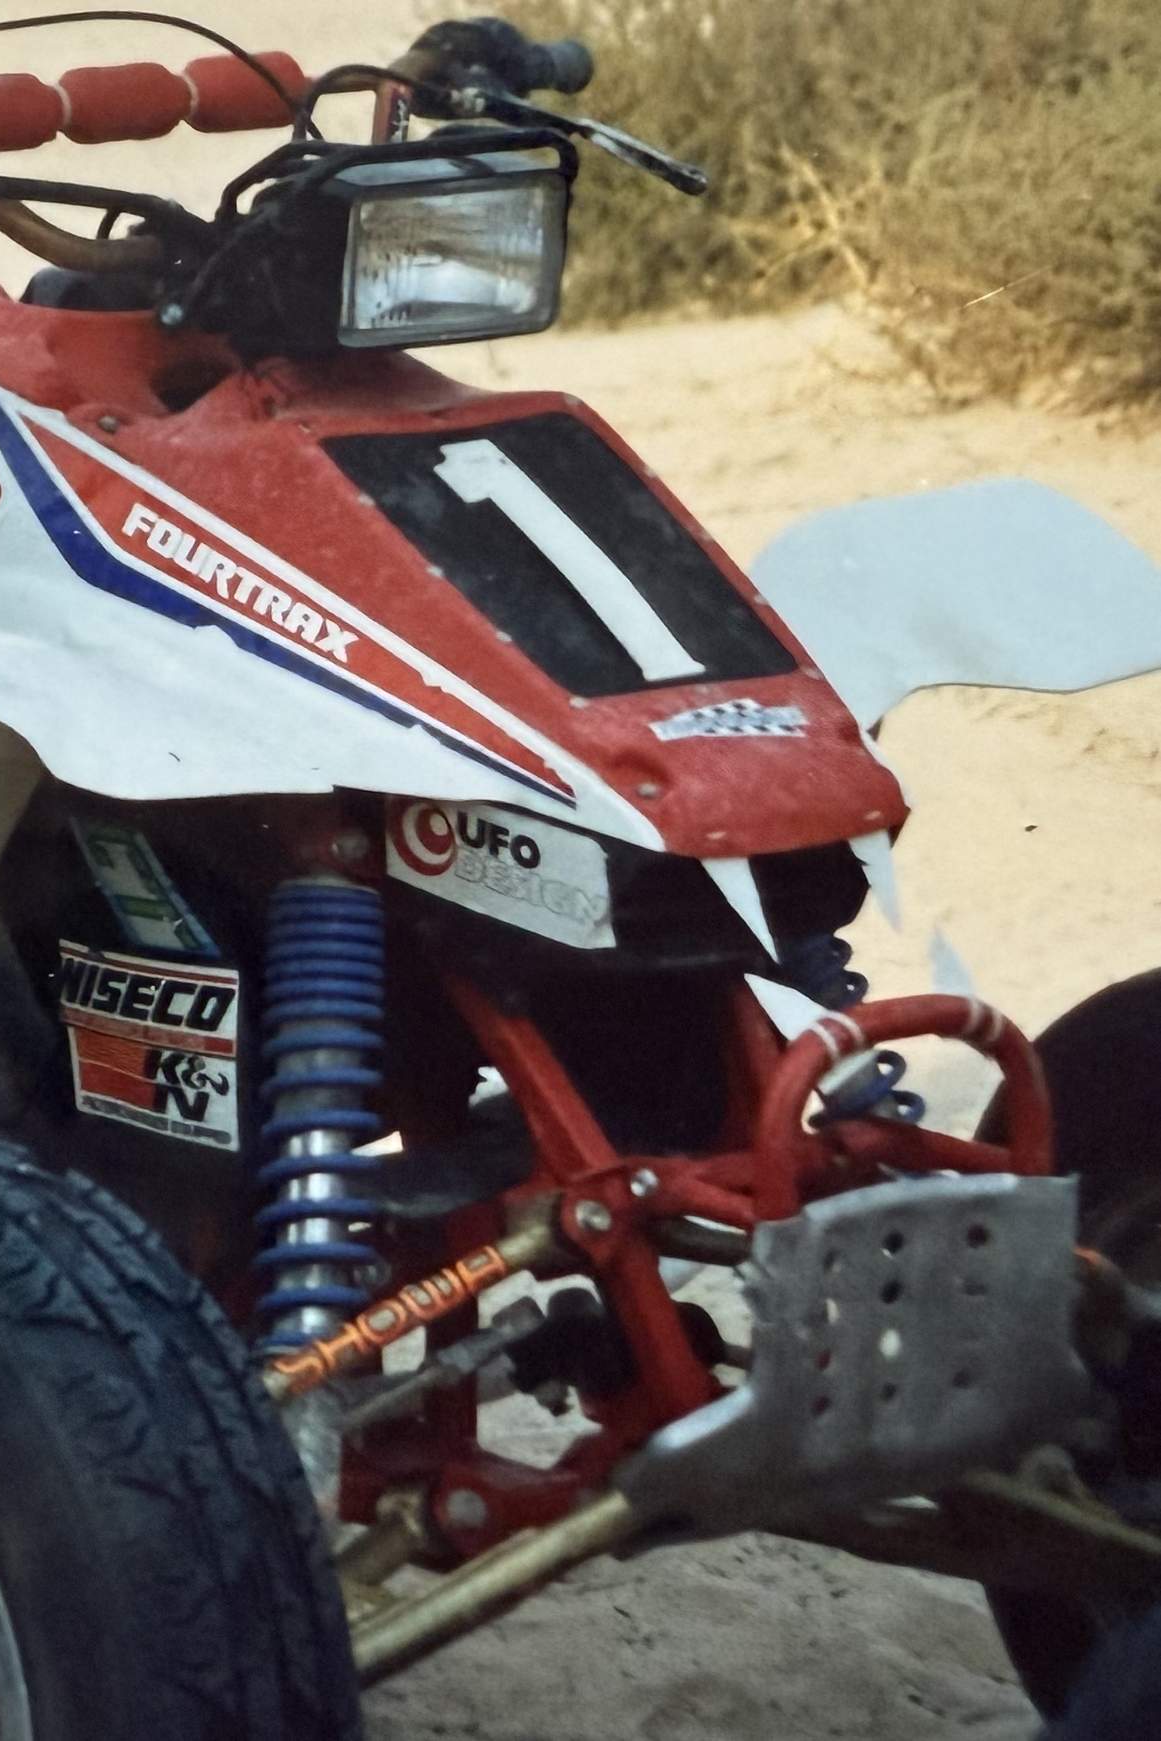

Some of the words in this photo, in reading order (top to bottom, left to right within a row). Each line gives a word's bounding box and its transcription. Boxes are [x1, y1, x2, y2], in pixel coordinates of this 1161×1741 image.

[121, 502, 360, 664] FOURTRAX
[434, 439, 706, 681] 1
[457, 810, 541, 869] UFO
[272, 1246, 506, 1395] SHOWA
